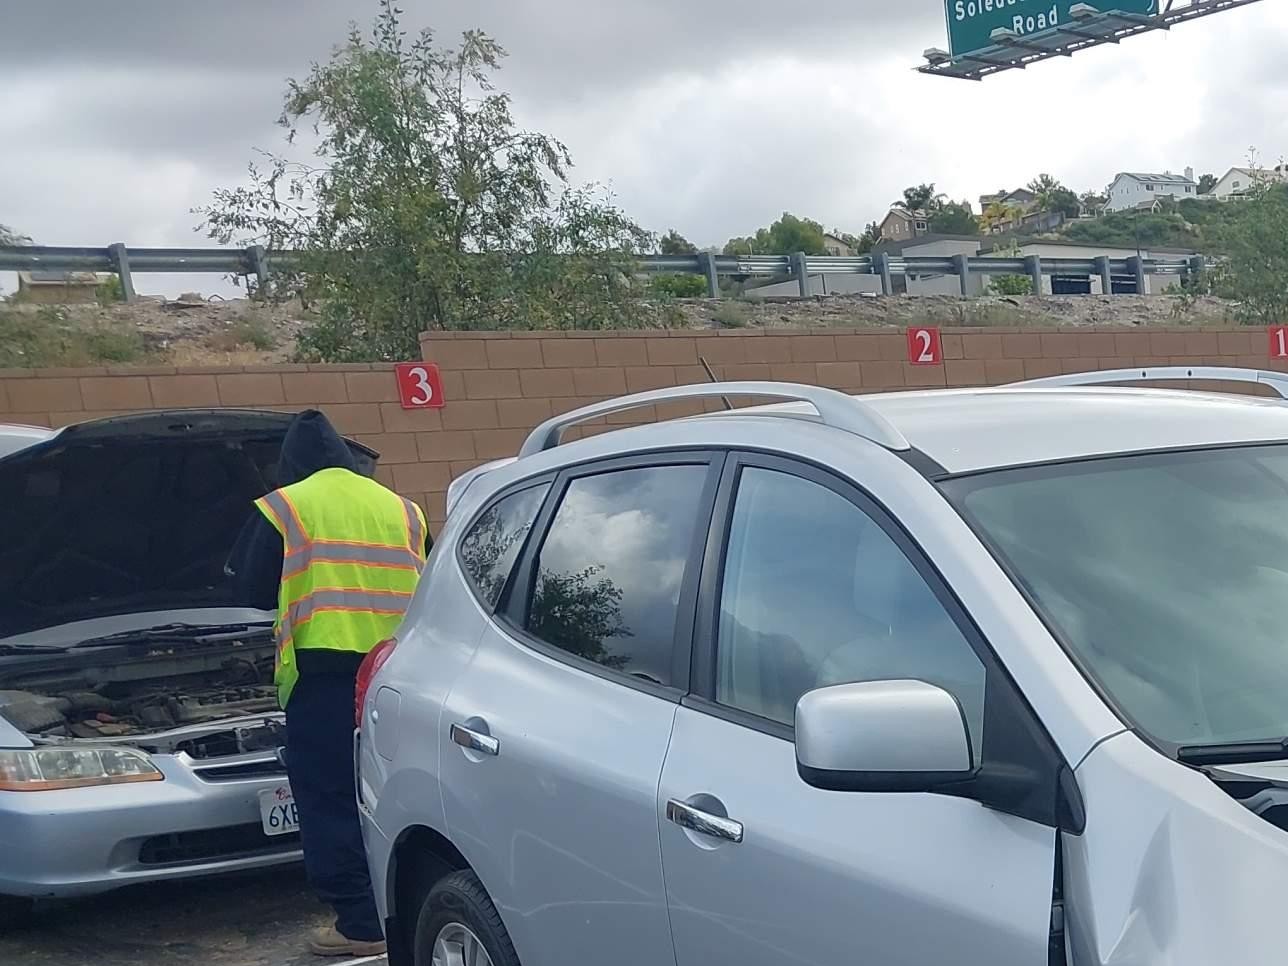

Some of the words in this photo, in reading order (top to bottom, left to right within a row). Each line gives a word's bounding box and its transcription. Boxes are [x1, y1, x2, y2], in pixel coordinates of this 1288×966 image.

[1013, 4, 1058, 34] Road
[916, 330, 933, 362] 2
[1275, 328, 1288, 357] 1
[408, 367, 432, 405] 3
